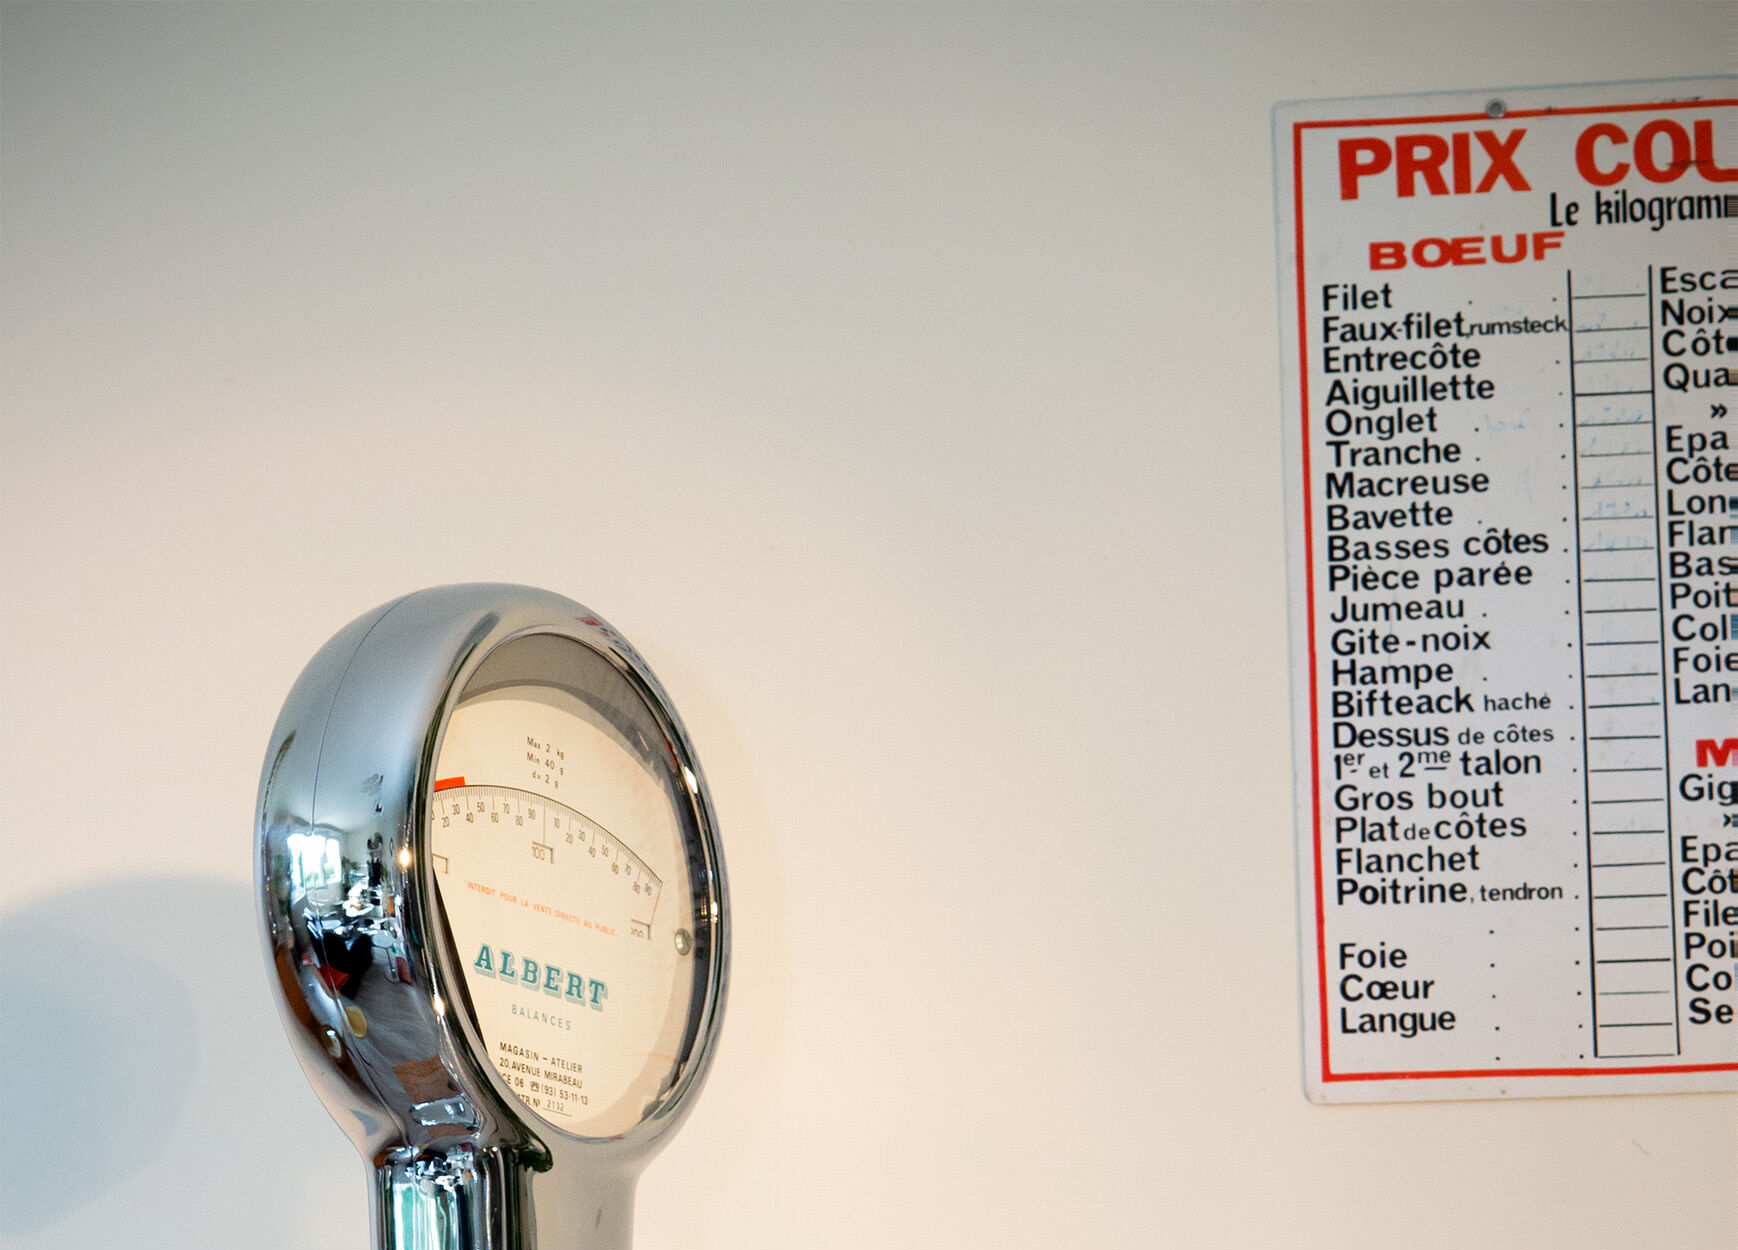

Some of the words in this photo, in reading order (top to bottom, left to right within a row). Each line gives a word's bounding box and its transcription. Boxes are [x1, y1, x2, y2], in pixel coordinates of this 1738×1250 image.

[1338, 128, 1531, 201] PRIX
[1550, 191, 1580, 228] Le
[1322, 282, 1393, 312] Filet
[1322, 341, 1482, 375] Entrecôte
[1324, 373, 1496, 412] Aiguillette
[1324, 405, 1438, 442] Onglet
[1325, 436, 1462, 468] Tranche
[1325, 470, 1490, 501] Macreuse
[1326, 500, 1454, 532] Bavette
[1327, 534, 1450, 563] Basses
[1463, 527, 1550, 557] côtes
[1328, 563, 1420, 593] Pièce
[1433, 560, 1533, 595] parée
[1329, 594, 1465, 624] Jumeau
[1671, 613, 1738, 643] Col
[1331, 658, 1454, 691] Hampe
[1331, 685, 1475, 719] Bifteack
[1483, 691, 1552, 713] haché
[1673, 676, 1738, 705] Lan
[546, 744, 550, 753] 2
[1332, 720, 1450, 750] Dessus
[1457, 727, 1485, 746] de
[1492, 723, 1555, 744] côtes
[545, 759, 554, 770] 40
[545, 774, 549, 784] 2
[1368, 761, 1389, 780] et
[1460, 749, 1543, 776] talon
[452, 804, 460, 815] 30
[477, 802, 485, 813] 50
[503, 803, 510, 814] 70
[528, 808, 535, 820] 90
[1333, 783, 1414, 812] Gros
[1427, 780, 1504, 810] bout
[442, 816, 450, 828] 20
[466, 812, 473, 823] 40
[491, 812, 498, 823] 60
[515, 815, 523, 826] 80
[1335, 815, 1400, 845] Plat
[1403, 822, 1431, 841] de
[1433, 810, 1527, 841] côtes
[1335, 844, 1480, 876] Flanchet
[499, 891, 517, 904] POUR
[520, 898, 528, 907] LA
[533, 903, 552, 915] VENTE
[555, 909, 580, 924] DIRECTE
[1479, 882, 1564, 903] tendron
[1339, 940, 1408, 971] Foie
[474, 943, 608, 1011] ALBERT
[1339, 973, 1436, 1003] Cœur
[511, 1004, 572, 1031] BALANCES
[1340, 1006, 1457, 1039] Langue
[500, 1042, 539, 1061] MAGASIN
[551, 1057, 583, 1073] ATELIER
[515, 1077, 524, 1087] 06
[544, 1070, 583, 1088] MIRABEAU
